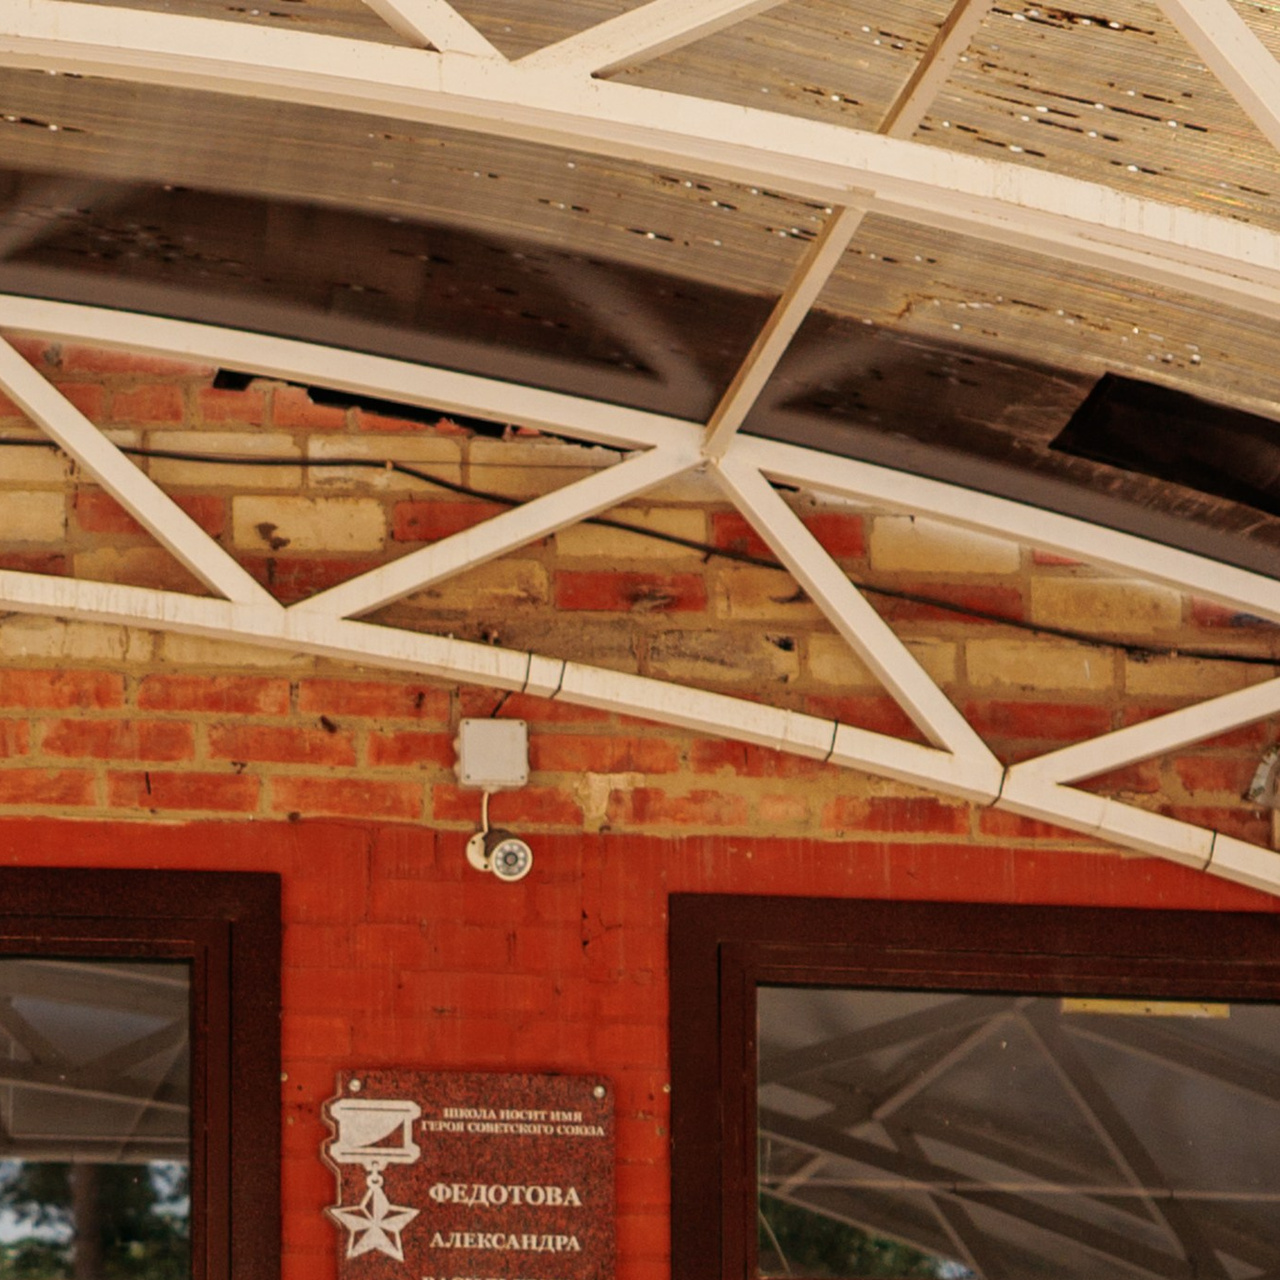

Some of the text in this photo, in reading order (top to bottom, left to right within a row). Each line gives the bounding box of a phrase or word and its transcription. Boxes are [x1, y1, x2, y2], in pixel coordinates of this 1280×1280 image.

[443, 1108, 582, 1122] ШКОЛА НОСИТ ИМЯ
[421, 1121, 605, 1136] ГЕРОЯ СОВЕТСКОГО СОЮЗА
[429, 1183, 583, 1207] ФЕДОТОВА
[430, 1232, 581, 1253] АЛЕКСАНДРА
